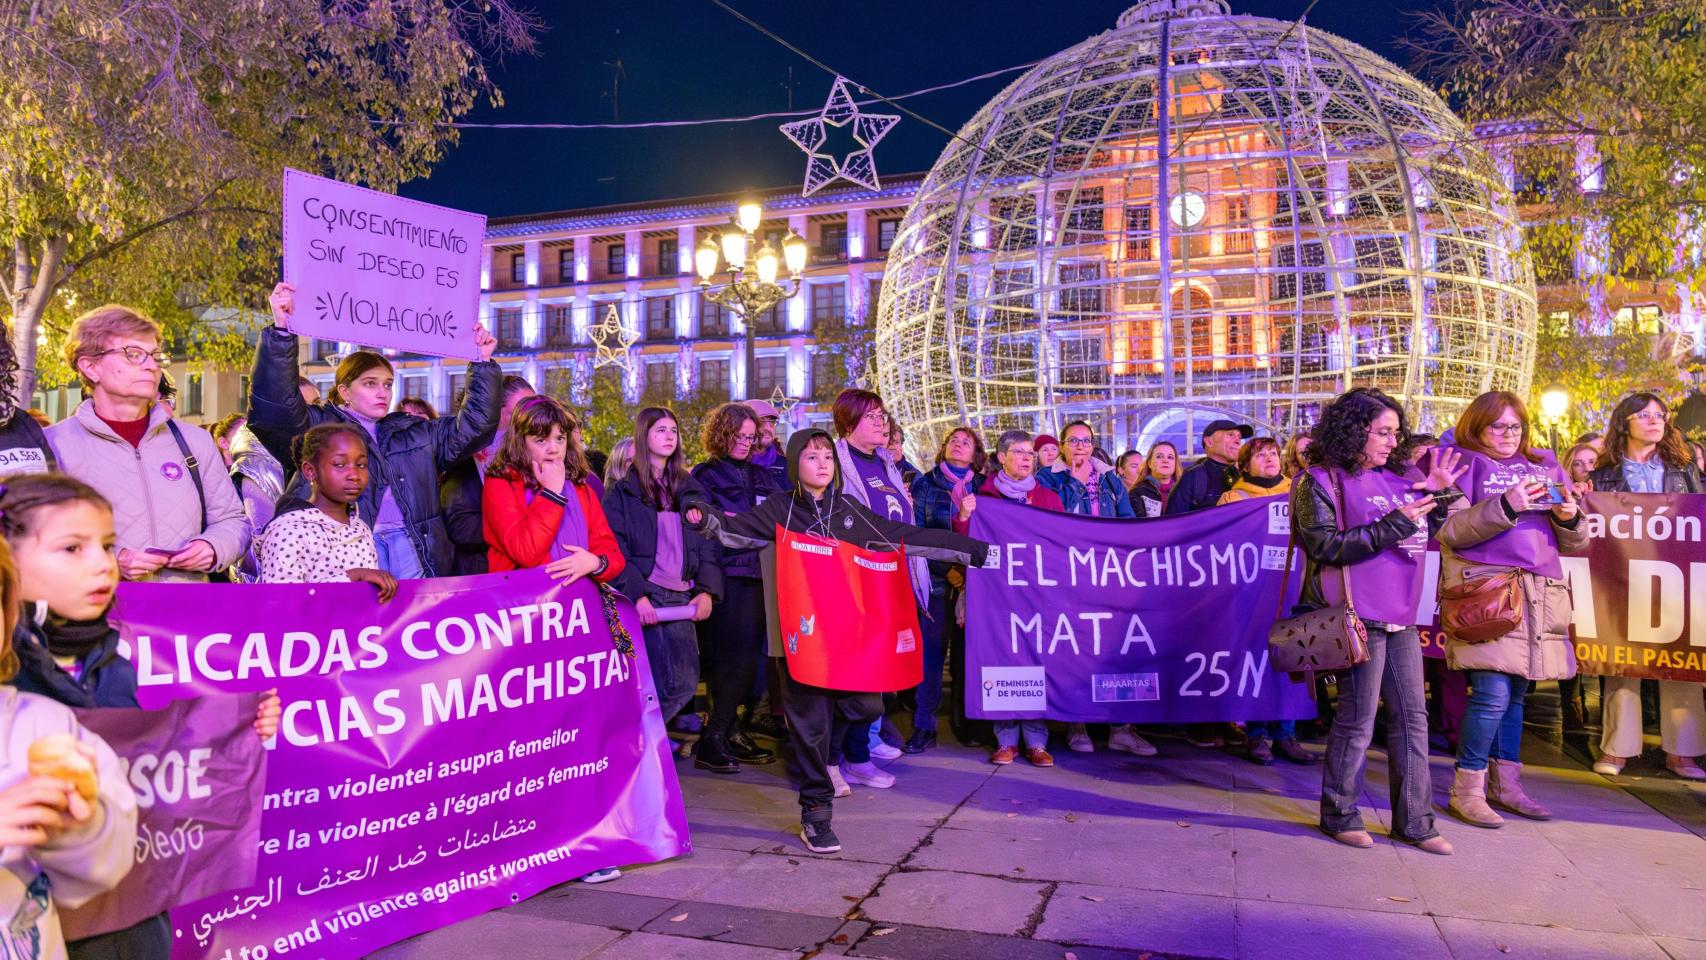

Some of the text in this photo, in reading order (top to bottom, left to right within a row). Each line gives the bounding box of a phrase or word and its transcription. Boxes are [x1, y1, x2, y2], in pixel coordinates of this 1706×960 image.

[304, 198, 467, 254] CONSENTIMIENTO
[309, 239, 459, 288] SIN DESEO ES
[327, 291, 453, 337] VIOLACIÓN
[1588, 506, 1701, 542] ación
[1006, 542, 1259, 588] EL MACHISMO
[116, 598, 591, 687] LICADAS CONTRA
[1010, 612, 1157, 656] MATA
[1575, 643, 1607, 663] ON
[1614, 647, 1637, 665] EL
[1643, 648, 1706, 671] PASA
[262, 689, 406, 750] CIAS
[120, 747, 213, 808] SOE
[263, 728, 578, 811] ntra violentei asupra femeilor
[287, 829, 311, 851] la
[318, 810, 420, 845] violence
[425, 802, 438, 821] à
[443, 780, 511, 818] l'égard
[515, 776, 544, 797] des
[548, 756, 609, 787] femmes
[135, 817, 204, 864] oledo
[388, 843, 428, 872] ضد
[438, 817, 537, 857] متضامنات
[297, 855, 379, 895] العنف
[273, 918, 322, 955] end
[324, 892, 418, 935] violence
[423, 864, 496, 905] against
[500, 844, 572, 878] women
